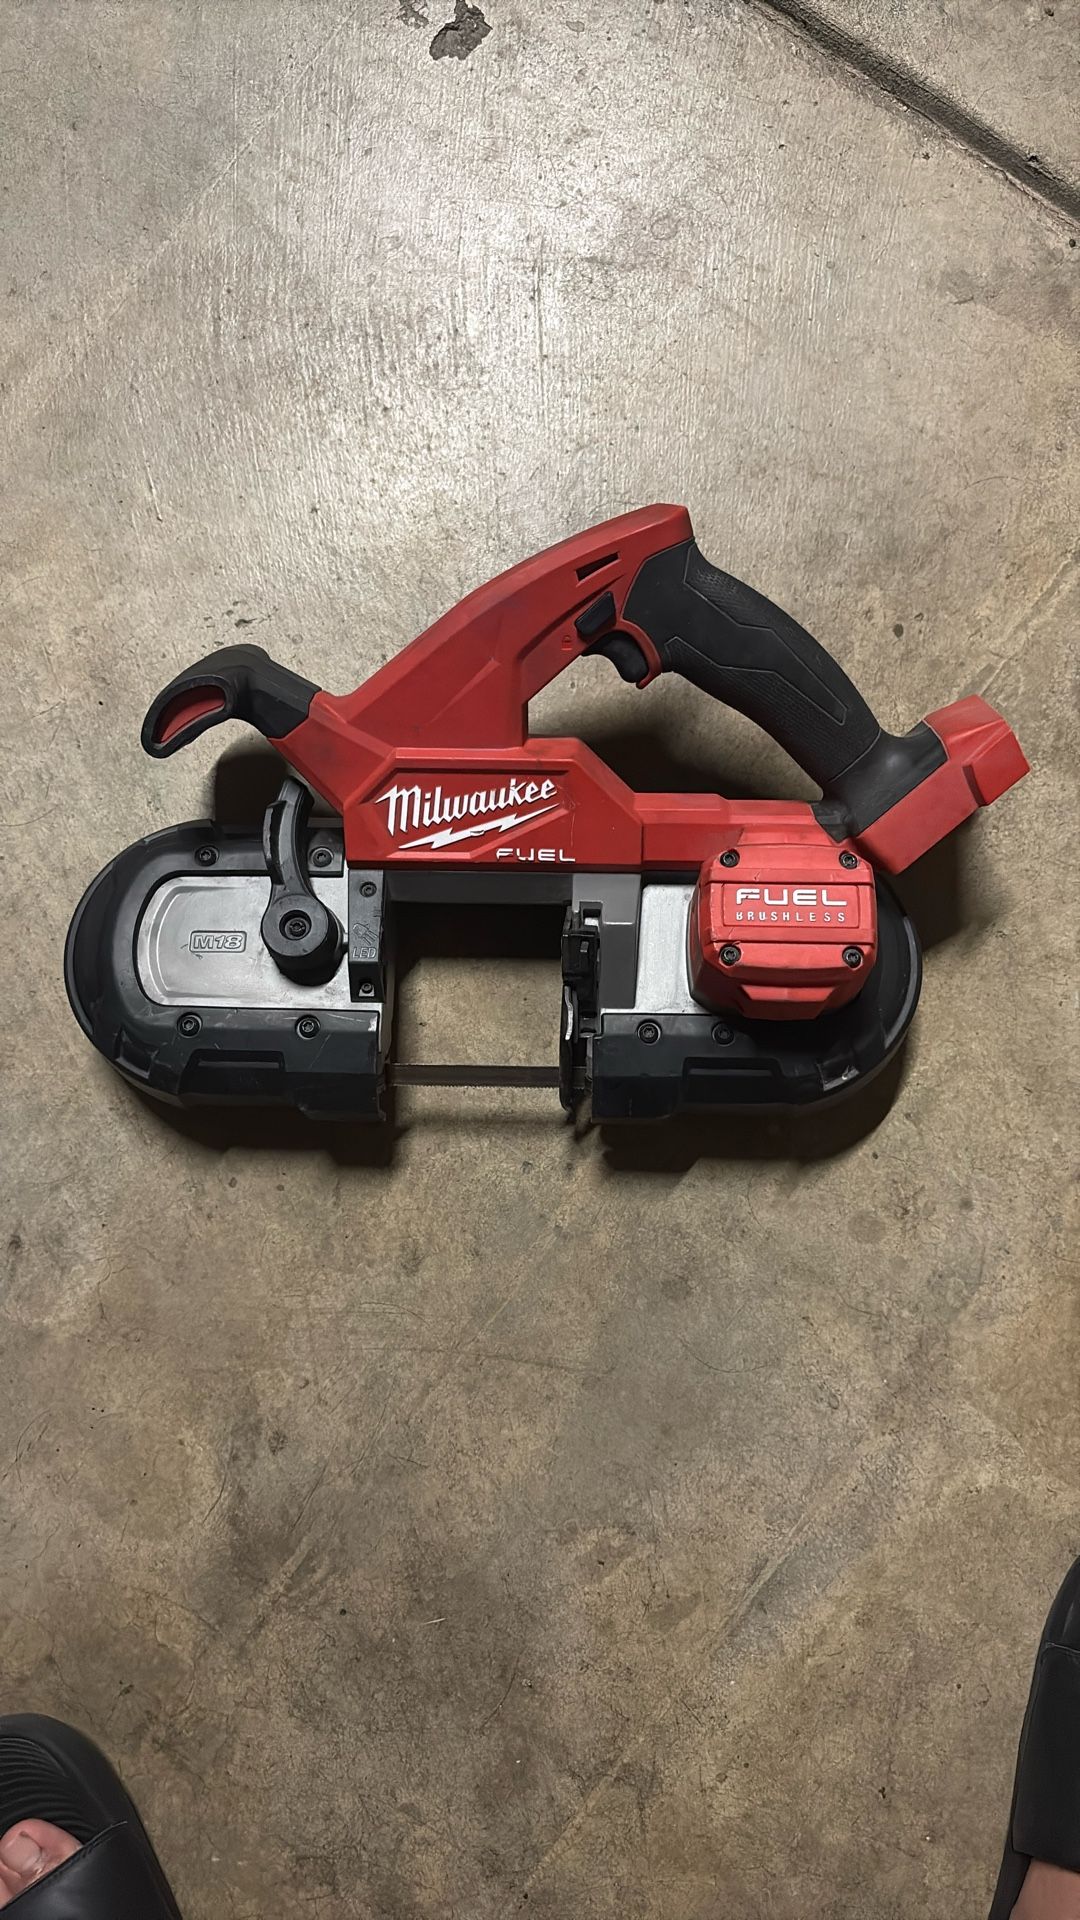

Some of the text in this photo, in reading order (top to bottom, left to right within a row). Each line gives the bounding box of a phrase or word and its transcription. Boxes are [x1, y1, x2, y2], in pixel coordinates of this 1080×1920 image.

[375, 778, 558, 836] Milwaukee
[496, 848, 576, 862] FUEL
[736, 888, 848, 906] FUEL
[736, 911, 845, 922] BRUSHLESS
[193, 934, 243, 949] M18
[352, 946, 377, 959] LED
